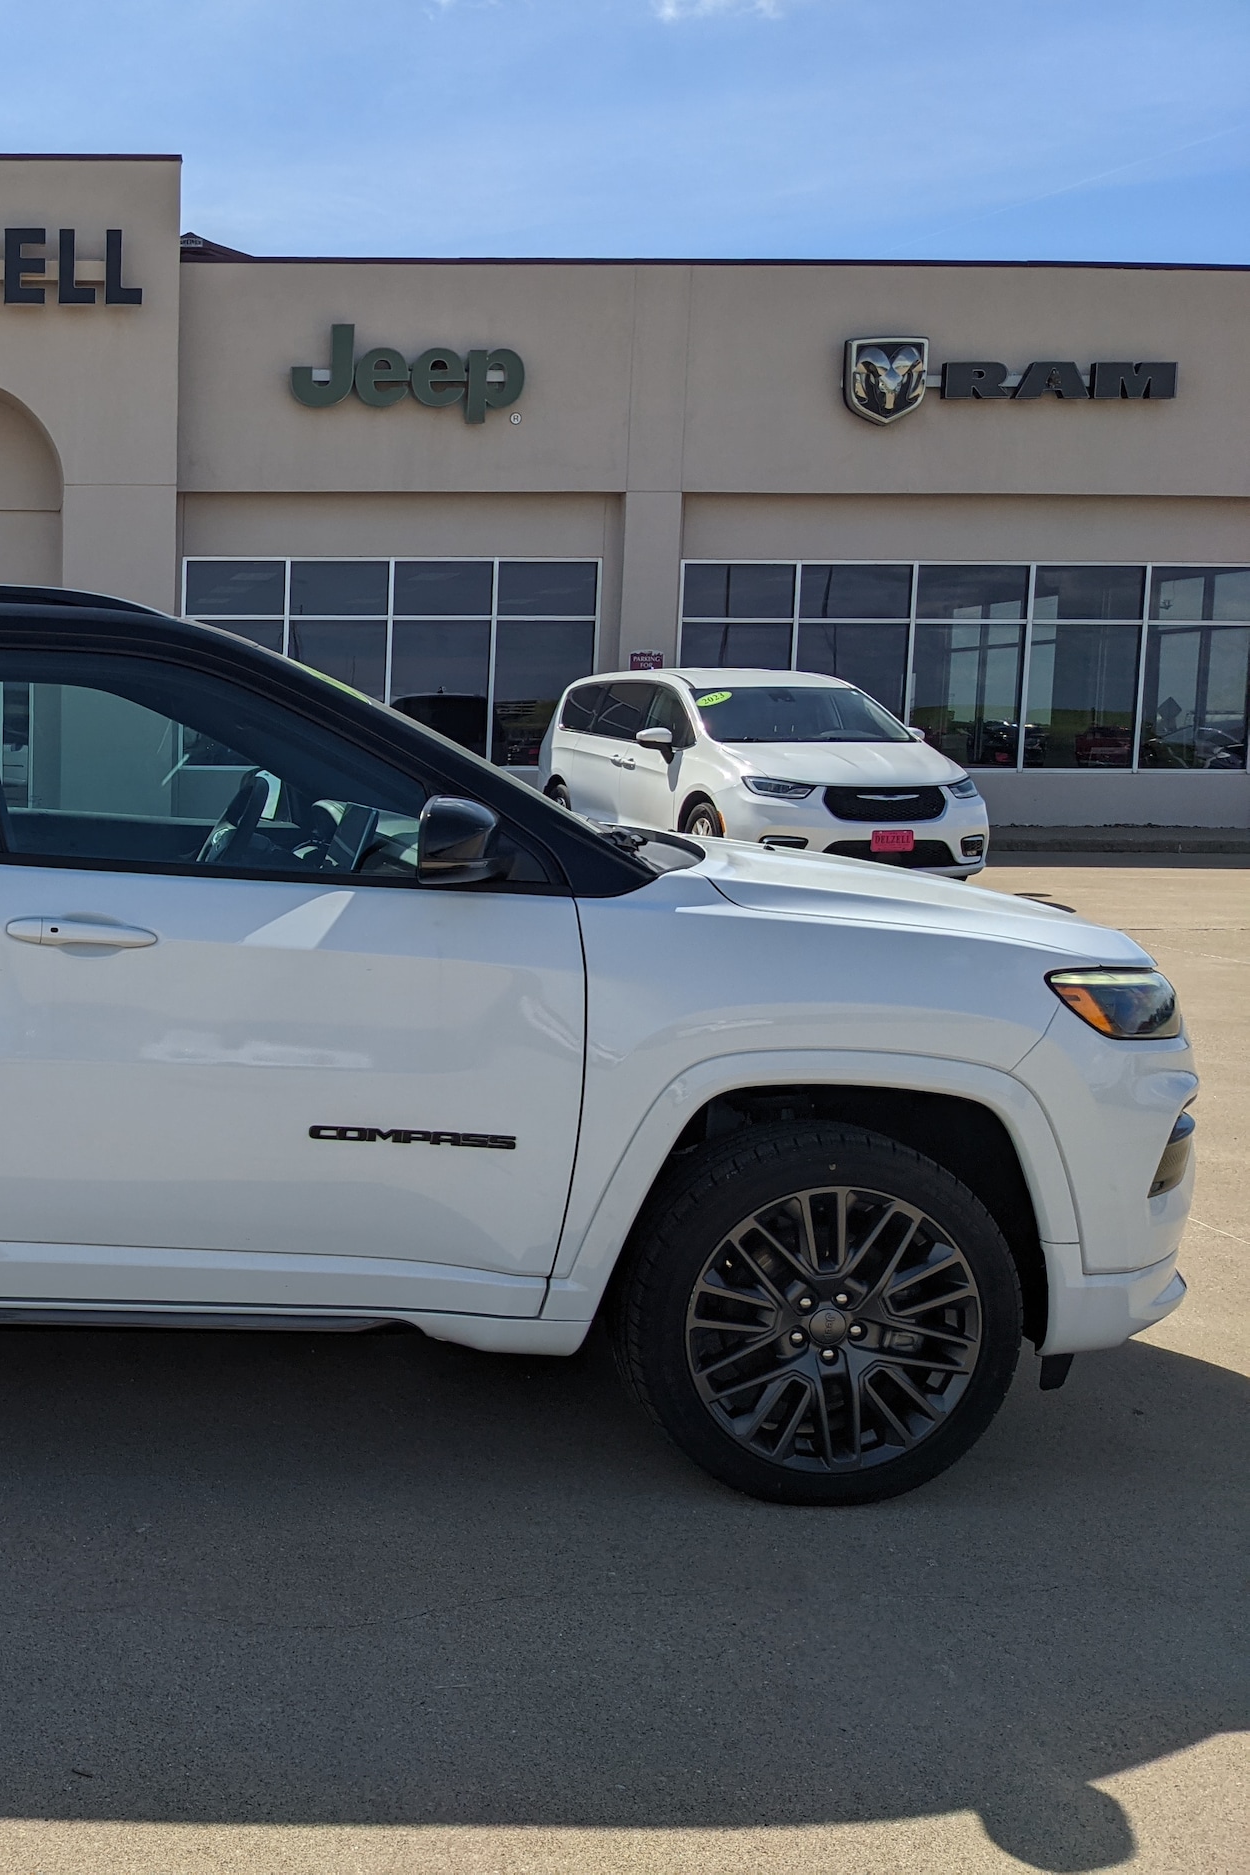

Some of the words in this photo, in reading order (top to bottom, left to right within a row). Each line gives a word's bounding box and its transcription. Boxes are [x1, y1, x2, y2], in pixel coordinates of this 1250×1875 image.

[290, 323, 525, 424] Jeep
[940, 361, 1179, 399] RAM
[702, 692, 725, 705] 2023
[874, 835, 910, 844] DELZELL
[309, 1125, 516, 1149] COMPASS
